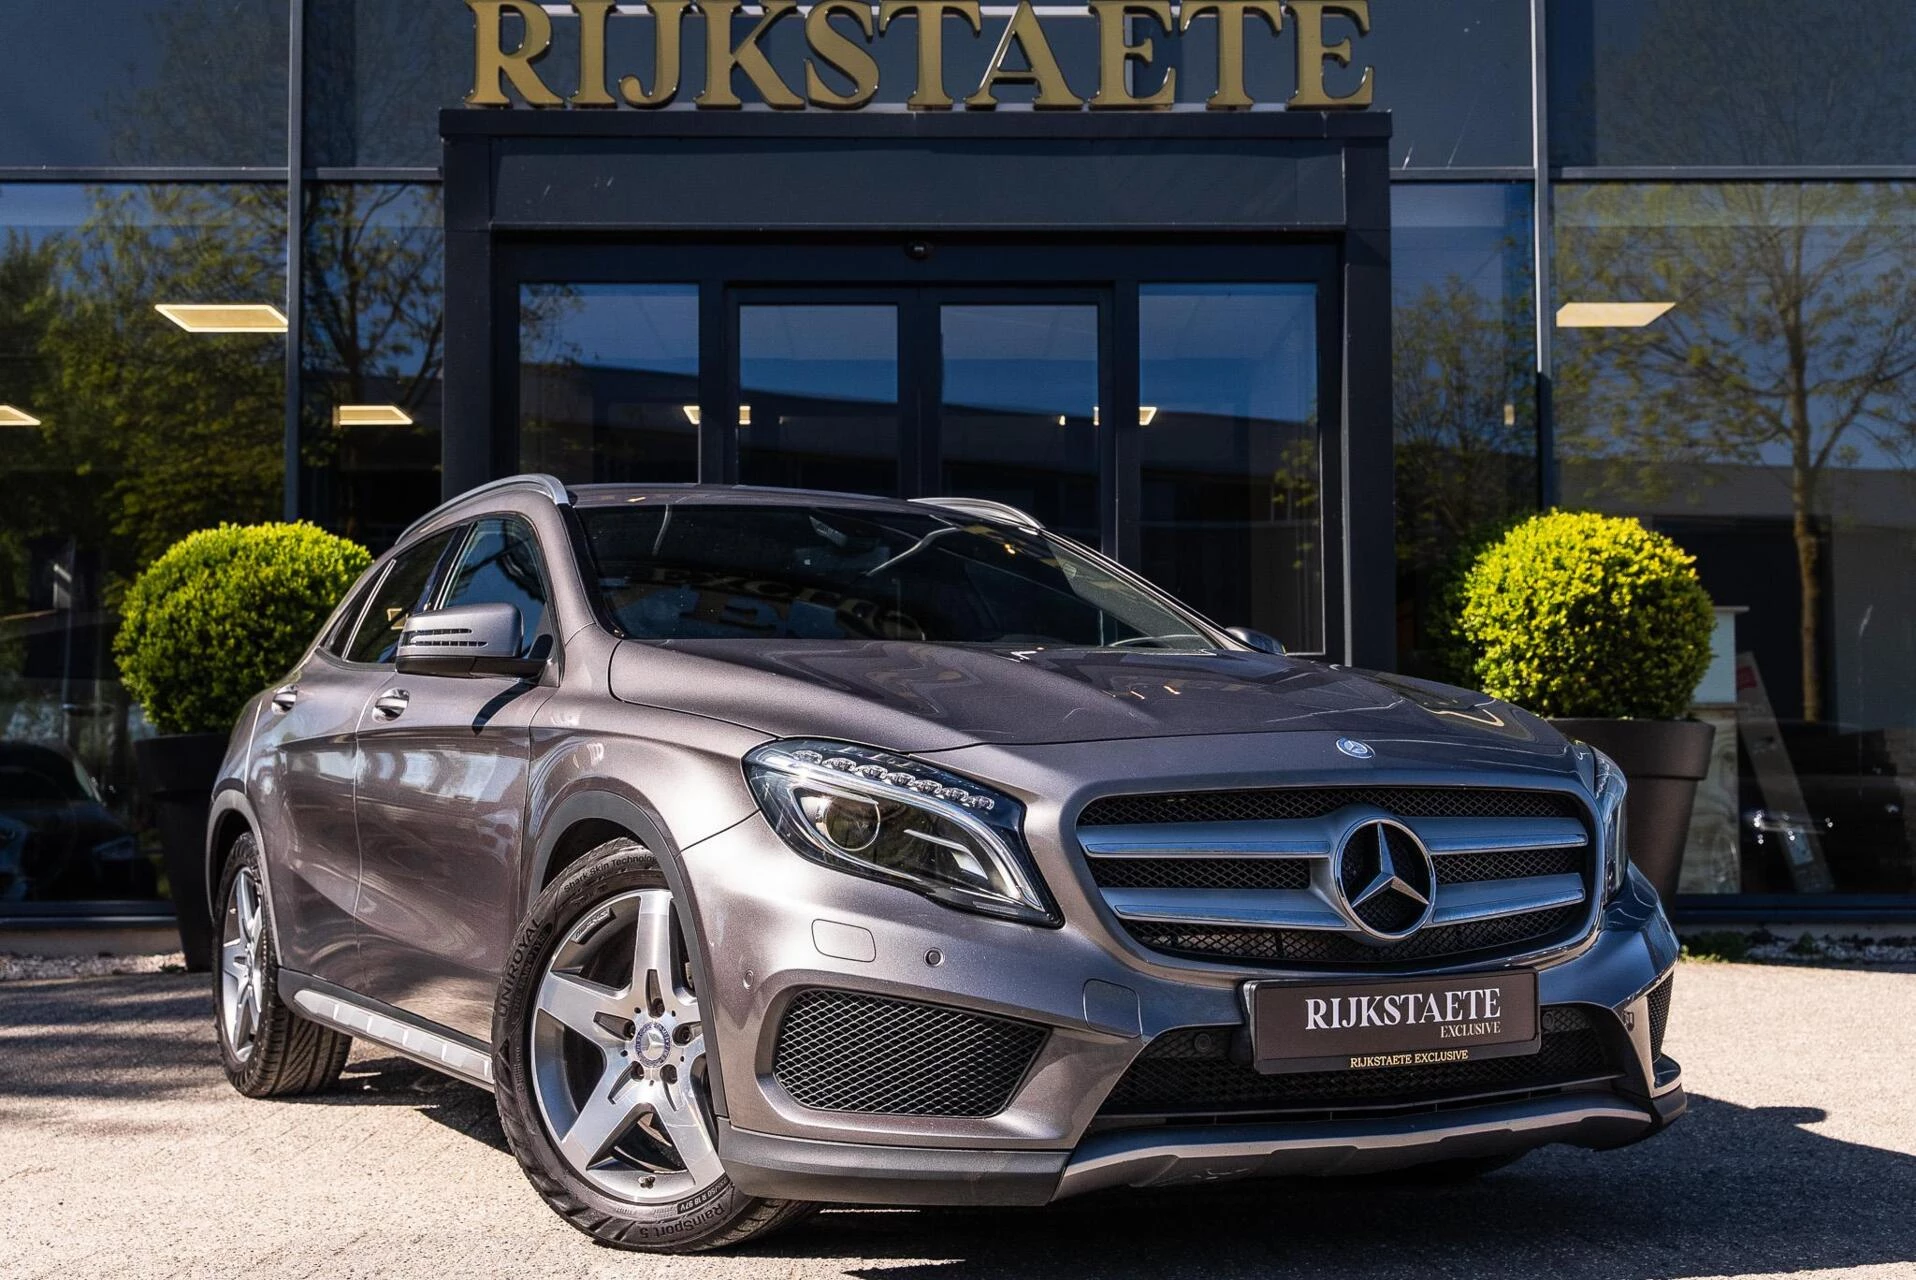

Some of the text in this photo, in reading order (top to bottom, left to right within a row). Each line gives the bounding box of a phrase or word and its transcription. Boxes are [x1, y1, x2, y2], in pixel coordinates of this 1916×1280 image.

[464, 0, 1374, 109] RIJKSTAETE
[564, 873, 589, 893] Shark
[590, 861, 609, 877] Skin
[499, 918, 543, 1017] UNIROYAL
[1305, 988, 1500, 1030] RIJKSTAETE
[1440, 1021, 1500, 1039] EXCLUSIVE
[1350, 1049, 1468, 1068] RIJKSTAETE EXCLUSIVE
[640, 1228, 649, 1239] 5
[653, 1203, 726, 1235] RainSport
